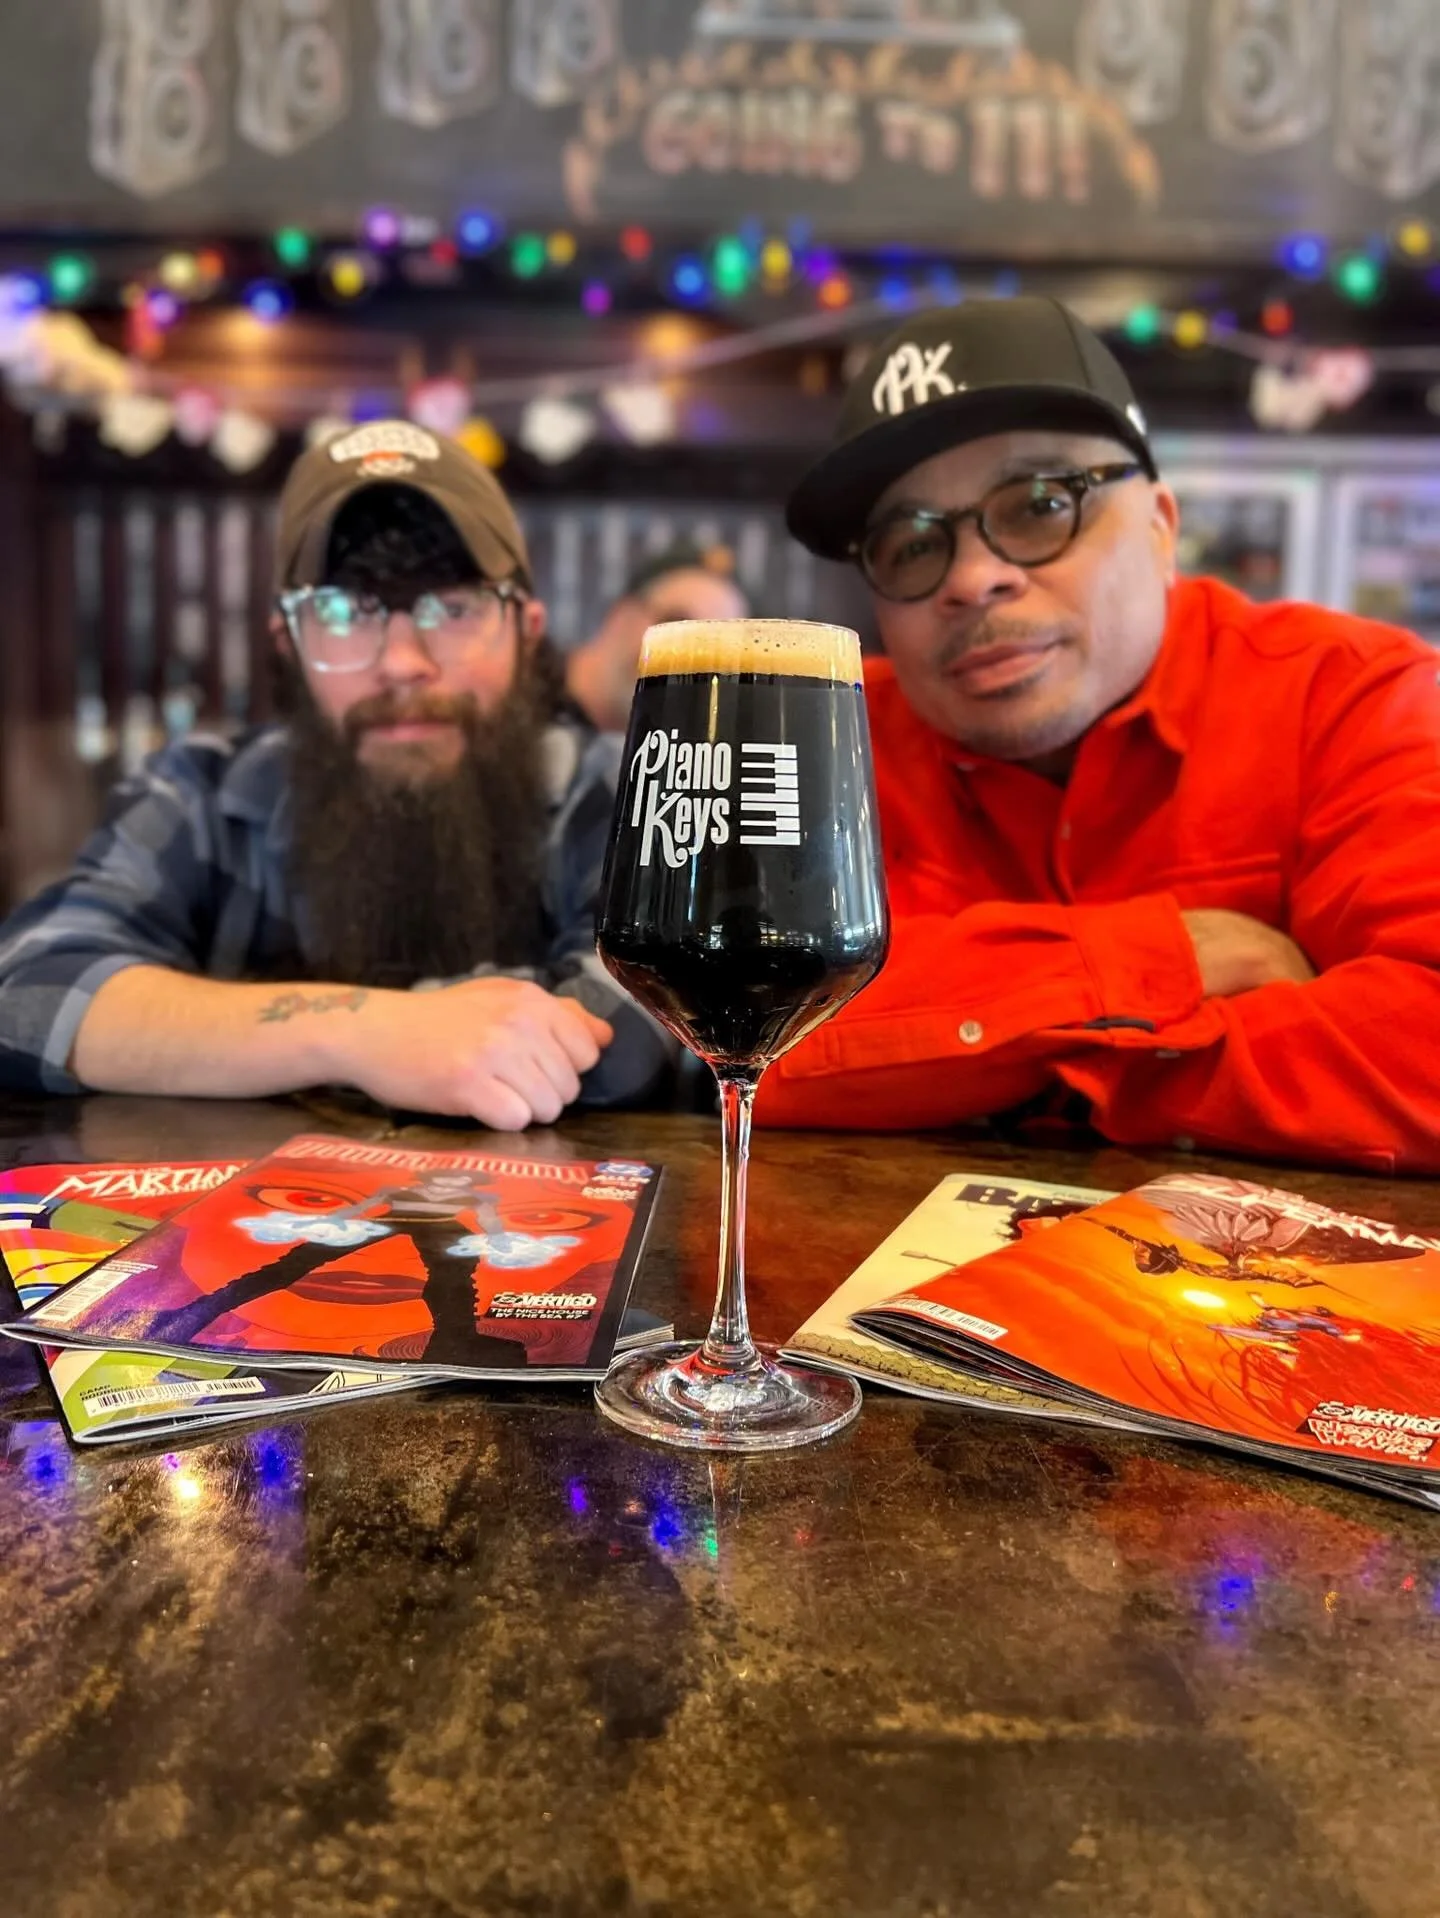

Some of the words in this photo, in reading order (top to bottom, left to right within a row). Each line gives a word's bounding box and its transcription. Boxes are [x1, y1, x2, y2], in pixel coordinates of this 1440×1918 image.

[630, 728, 731, 827] Piano
[640, 780, 730, 868] Keys
[522, 1294, 598, 1307] VERTIGO
